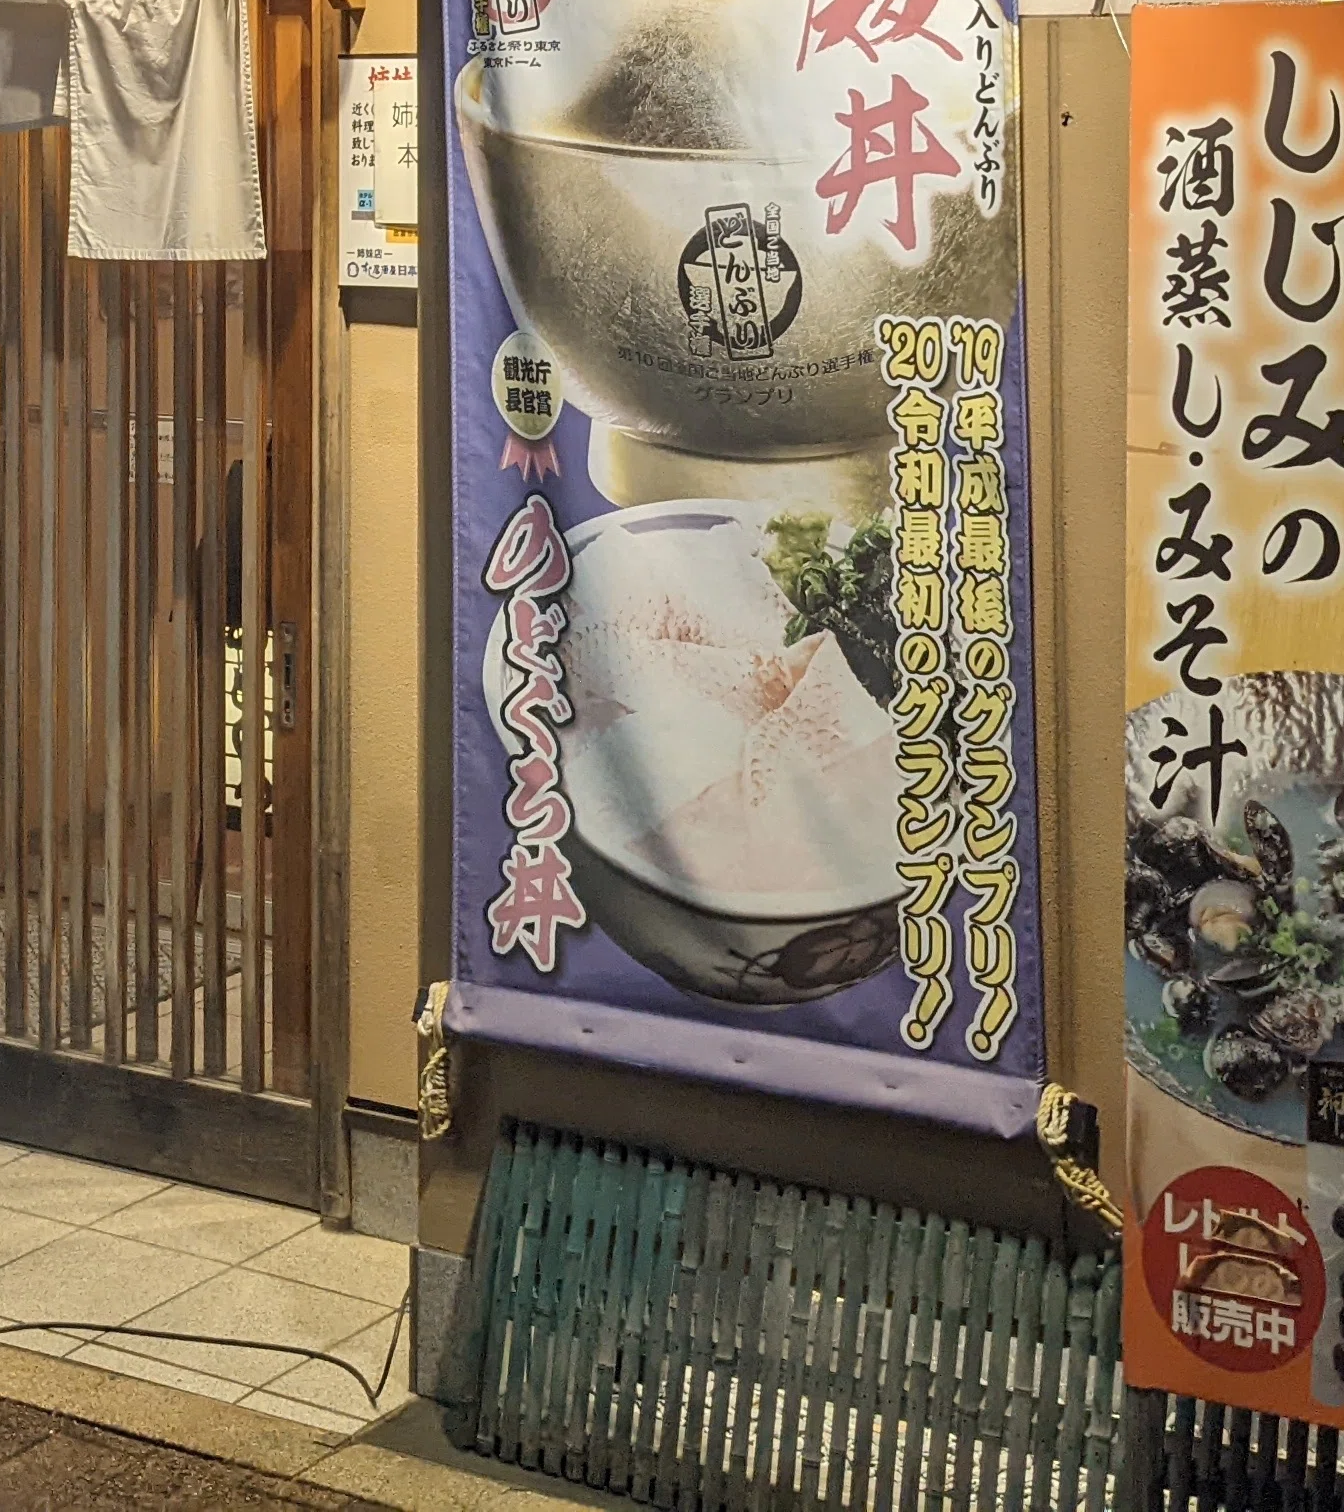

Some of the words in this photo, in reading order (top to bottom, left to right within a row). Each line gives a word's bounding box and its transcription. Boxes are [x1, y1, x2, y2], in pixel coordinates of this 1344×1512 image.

[468, 40, 561, 53] ふるさと祭り東京
[483, 57, 542, 68] 東京ドーム
[352, 102, 375, 116] 近く
[392, 101, 418, 128] 姉
[352, 119, 375, 133] 料理
[351, 137, 375, 150] 致し
[765, 202, 781, 283] 全国ご当地
[716, 212, 759, 350] どんぶり
[503, 356, 552, 385] 観光庁
[505, 387, 552, 417] 長官賞
[694, 388, 794, 406] グランプリ
[1149, 116, 1249, 830] 酒蒸し・みそ汁
[488, 498, 584, 970] のどぐろ丼
[1164, 1191, 1307, 1246] レトト
[1171, 1289, 1295, 1355] 販売中
